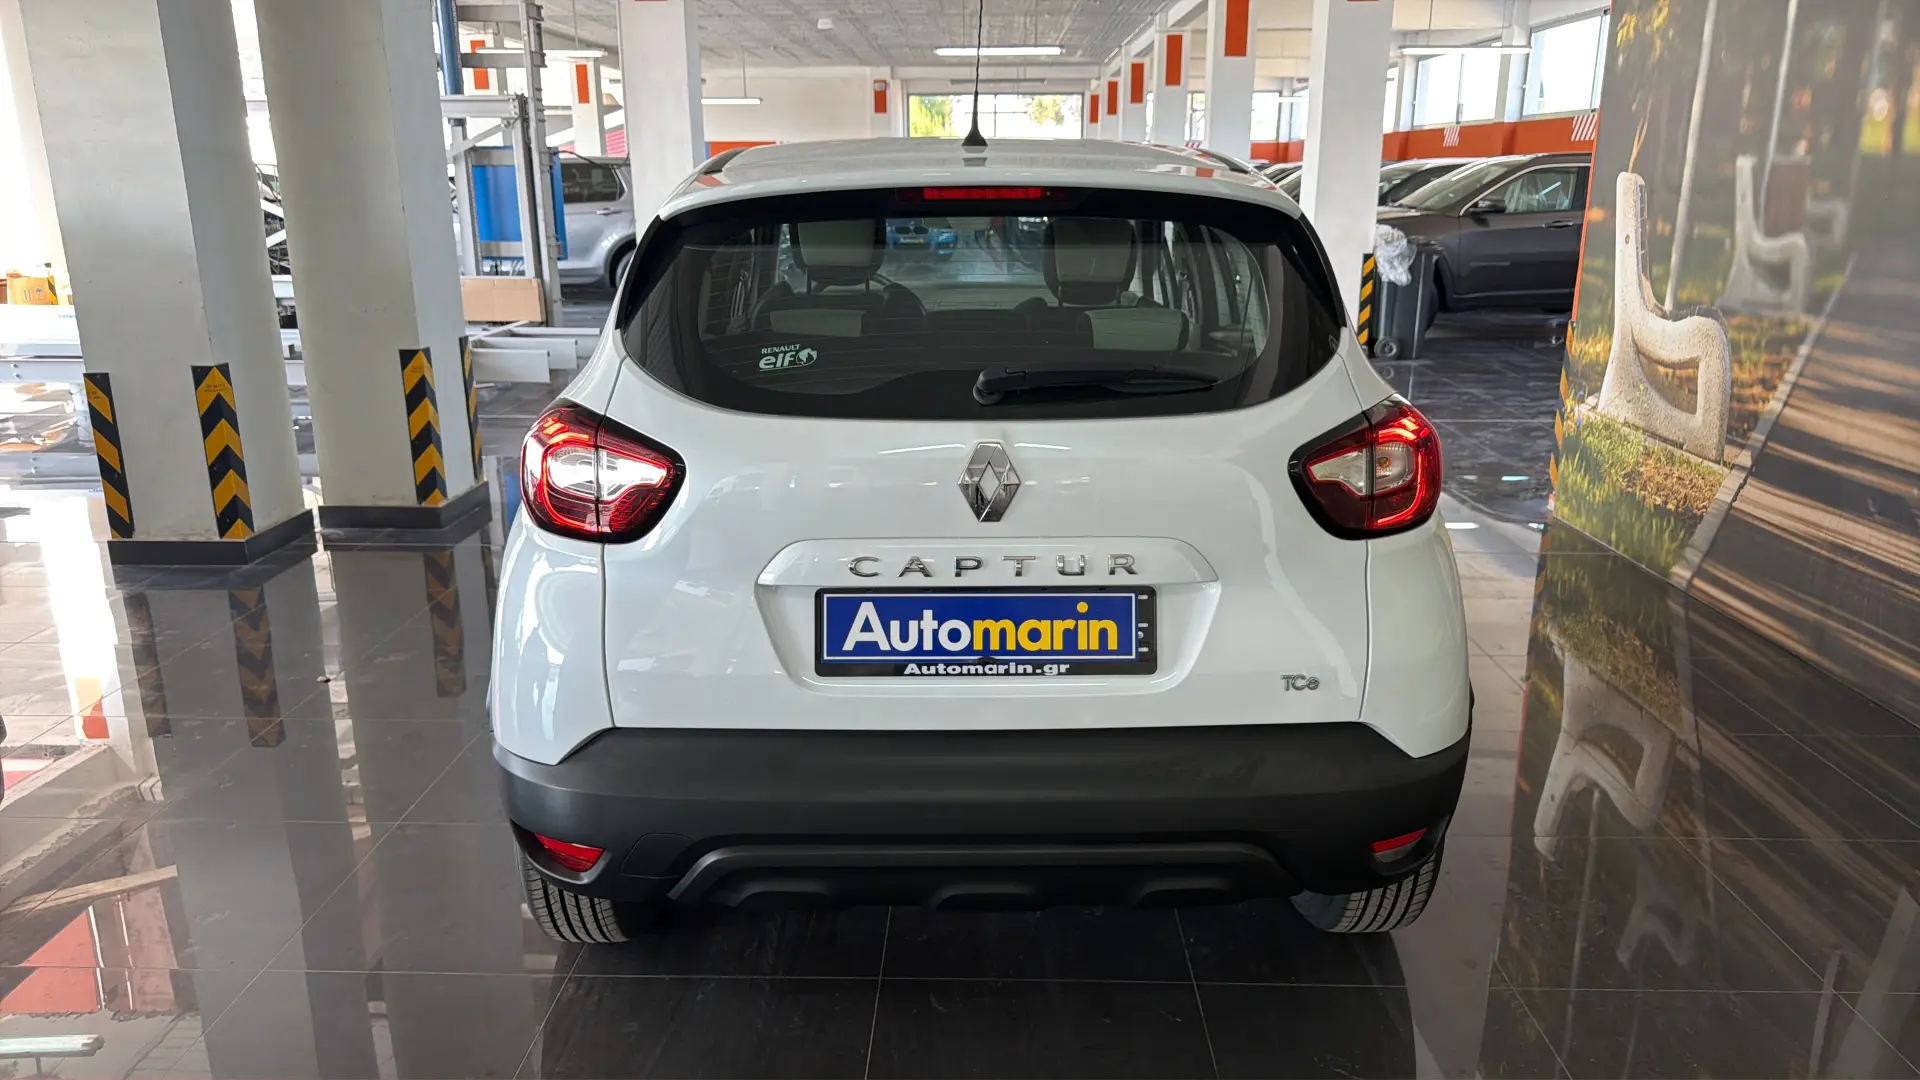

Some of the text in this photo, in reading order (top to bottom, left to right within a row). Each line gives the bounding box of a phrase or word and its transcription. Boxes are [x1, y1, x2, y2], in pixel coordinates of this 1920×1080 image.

[761, 343, 801, 355] RENAULT
[758, 352, 796, 369] elf
[848, 553, 1138, 578] CAPTUR
[842, 601, 1118, 651] Automarin
[903, 662, 1070, 676] Automarin.gr
[1280, 674, 1320, 691] TCe
